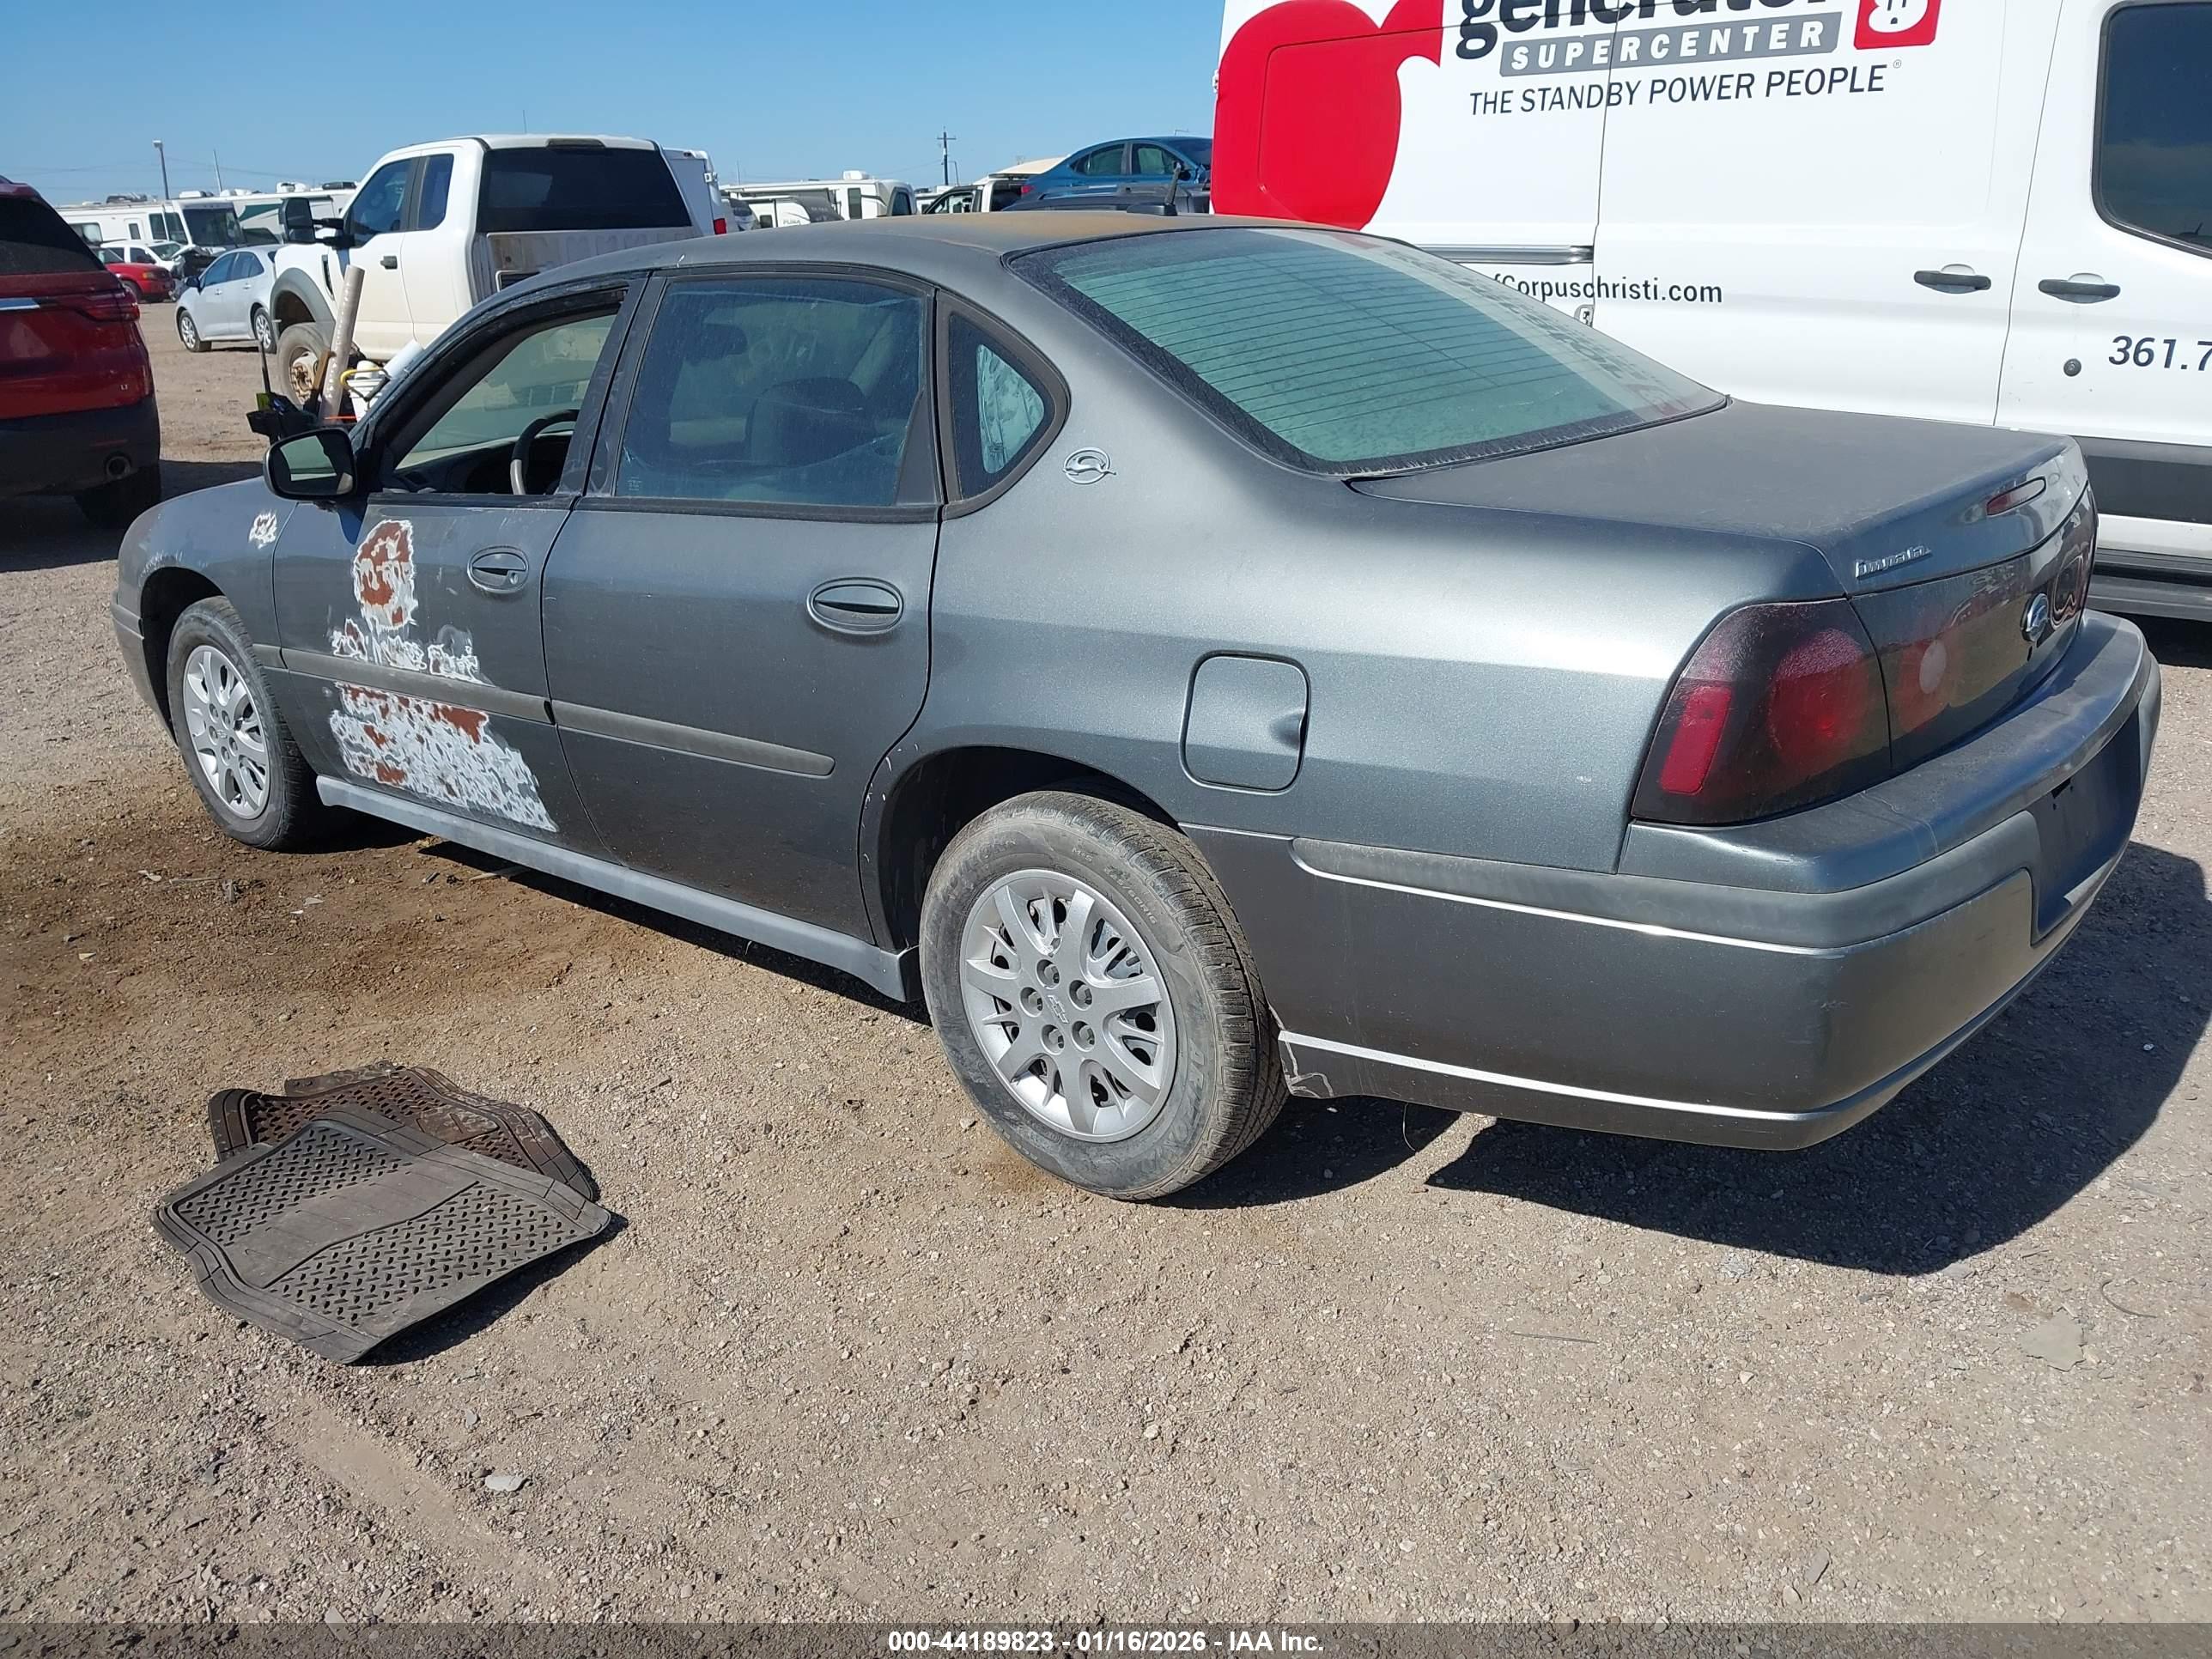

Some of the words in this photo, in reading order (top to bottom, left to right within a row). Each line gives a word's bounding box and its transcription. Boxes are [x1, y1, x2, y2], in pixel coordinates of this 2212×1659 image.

[1510, 20, 1825, 70] SUPERCENTER
[1469, 89, 1514, 115] THE
[1520, 80, 1642, 112] STANDBY
[1649, 72, 1755, 104] POWER
